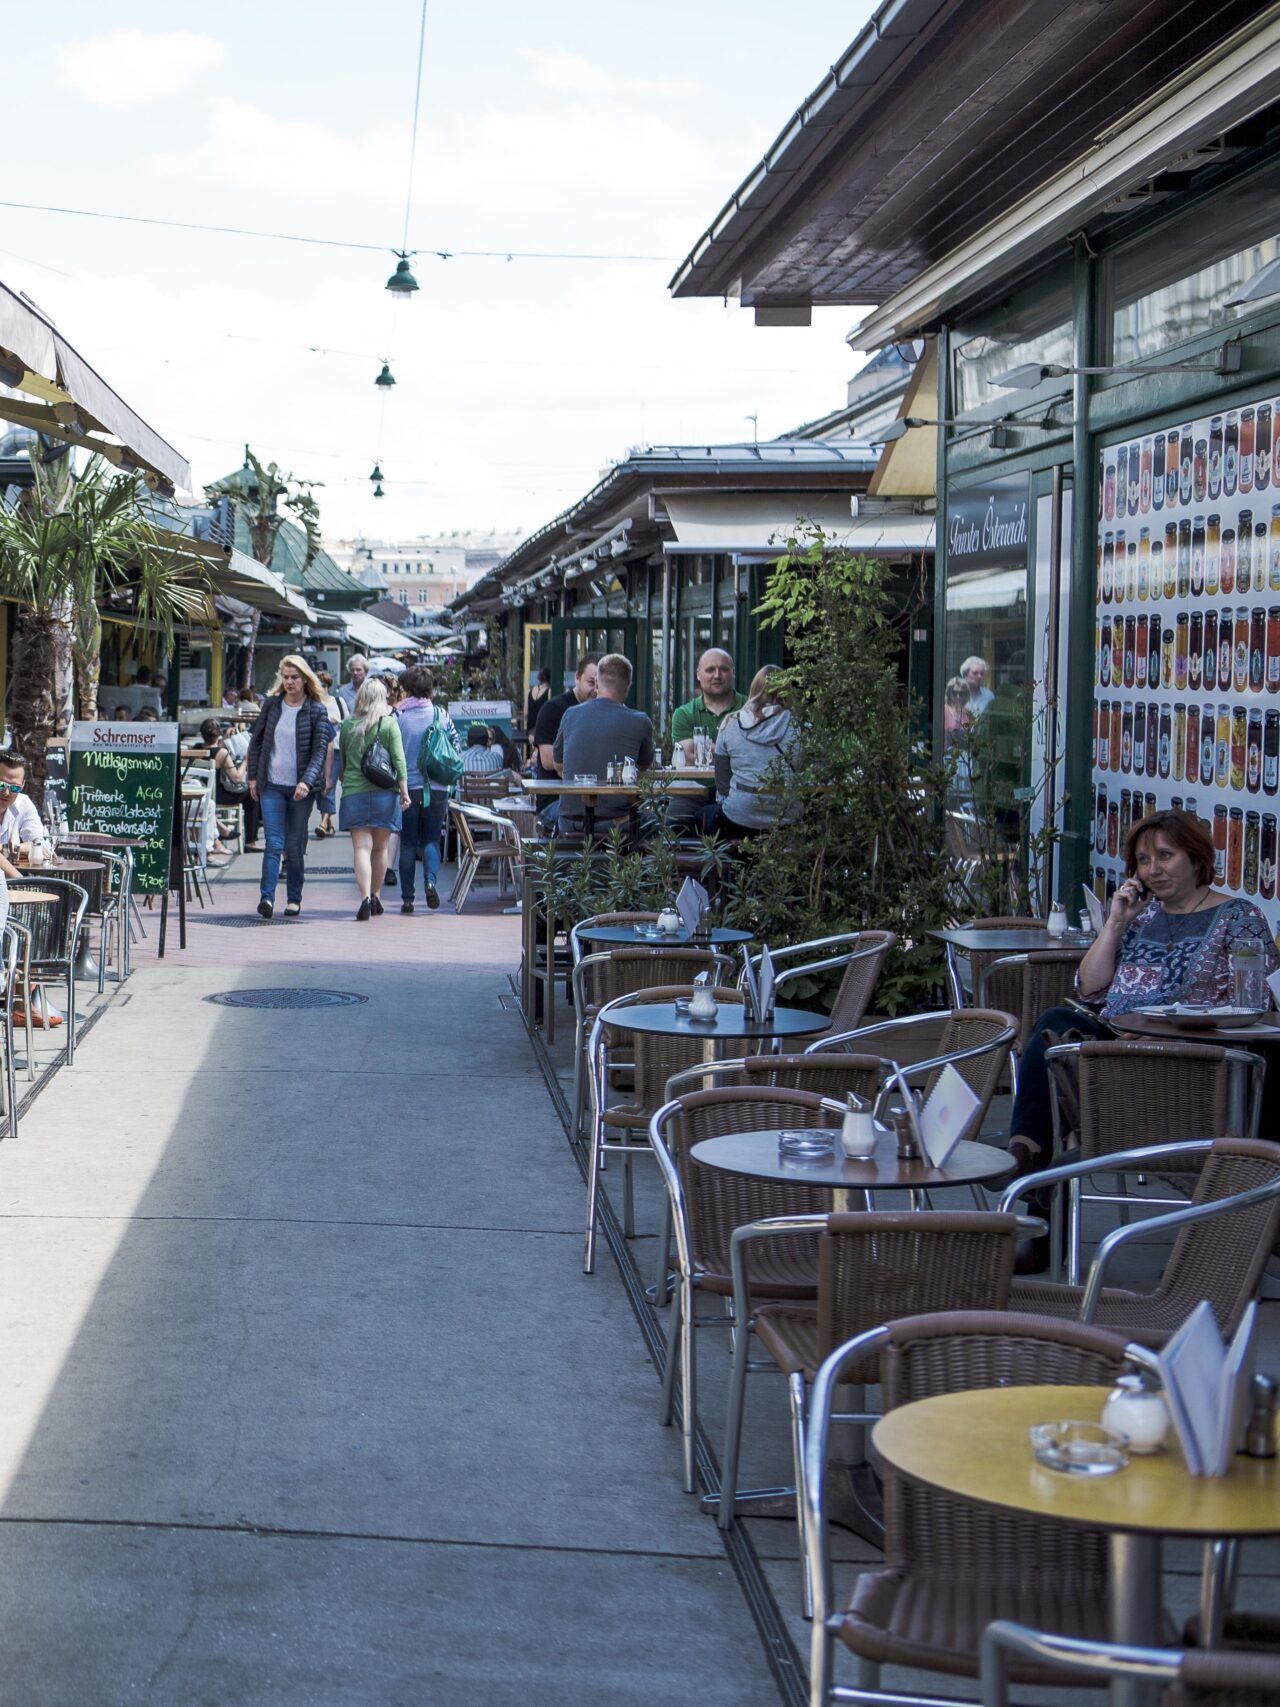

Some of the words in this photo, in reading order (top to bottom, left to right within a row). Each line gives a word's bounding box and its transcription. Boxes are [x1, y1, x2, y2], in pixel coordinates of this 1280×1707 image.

[93, 728, 156, 744] Schremser
[73, 819, 94, 832] mit
[94, 819, 159, 835] Tomatensalat
